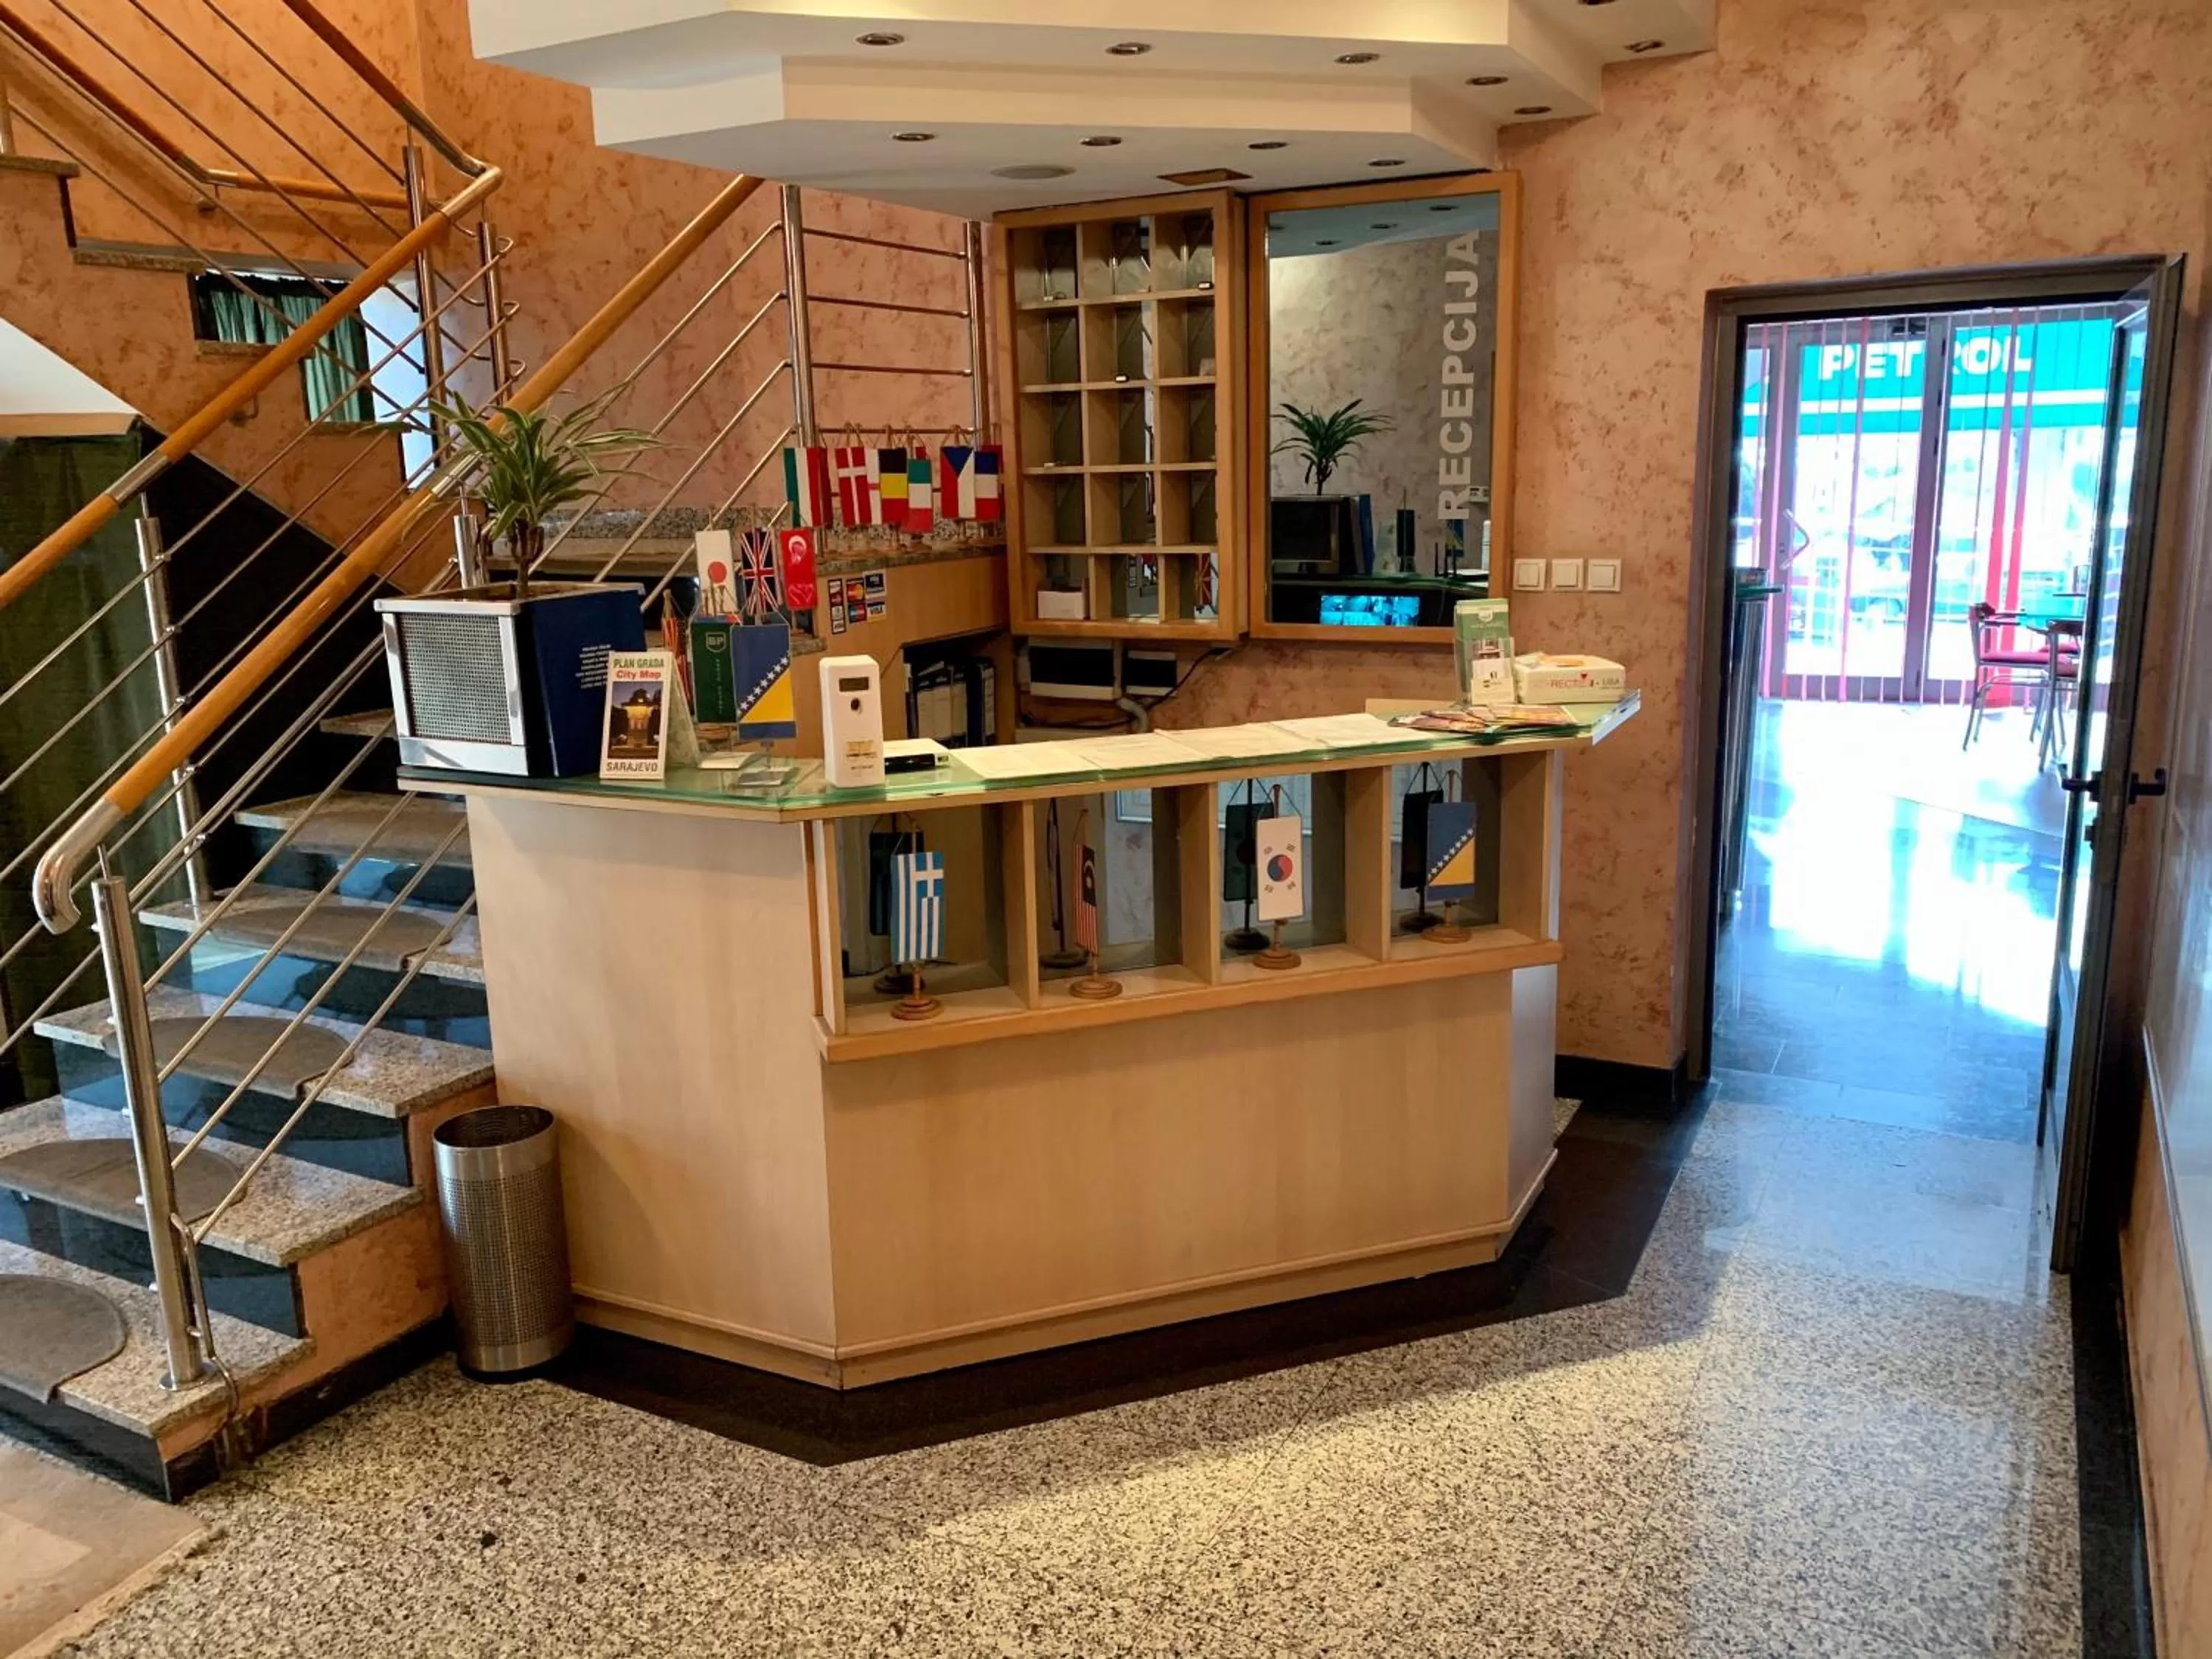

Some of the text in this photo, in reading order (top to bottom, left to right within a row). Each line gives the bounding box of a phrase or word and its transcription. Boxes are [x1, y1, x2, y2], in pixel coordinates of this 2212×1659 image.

[1438, 230, 1480, 520] RECEPCIJA
[613, 658, 635, 668] PLAN
[636, 658, 664, 668] GRADA
[616, 669, 636, 680] City
[640, 669, 661, 679] Map
[606, 761, 658, 772] SARAJEVO
